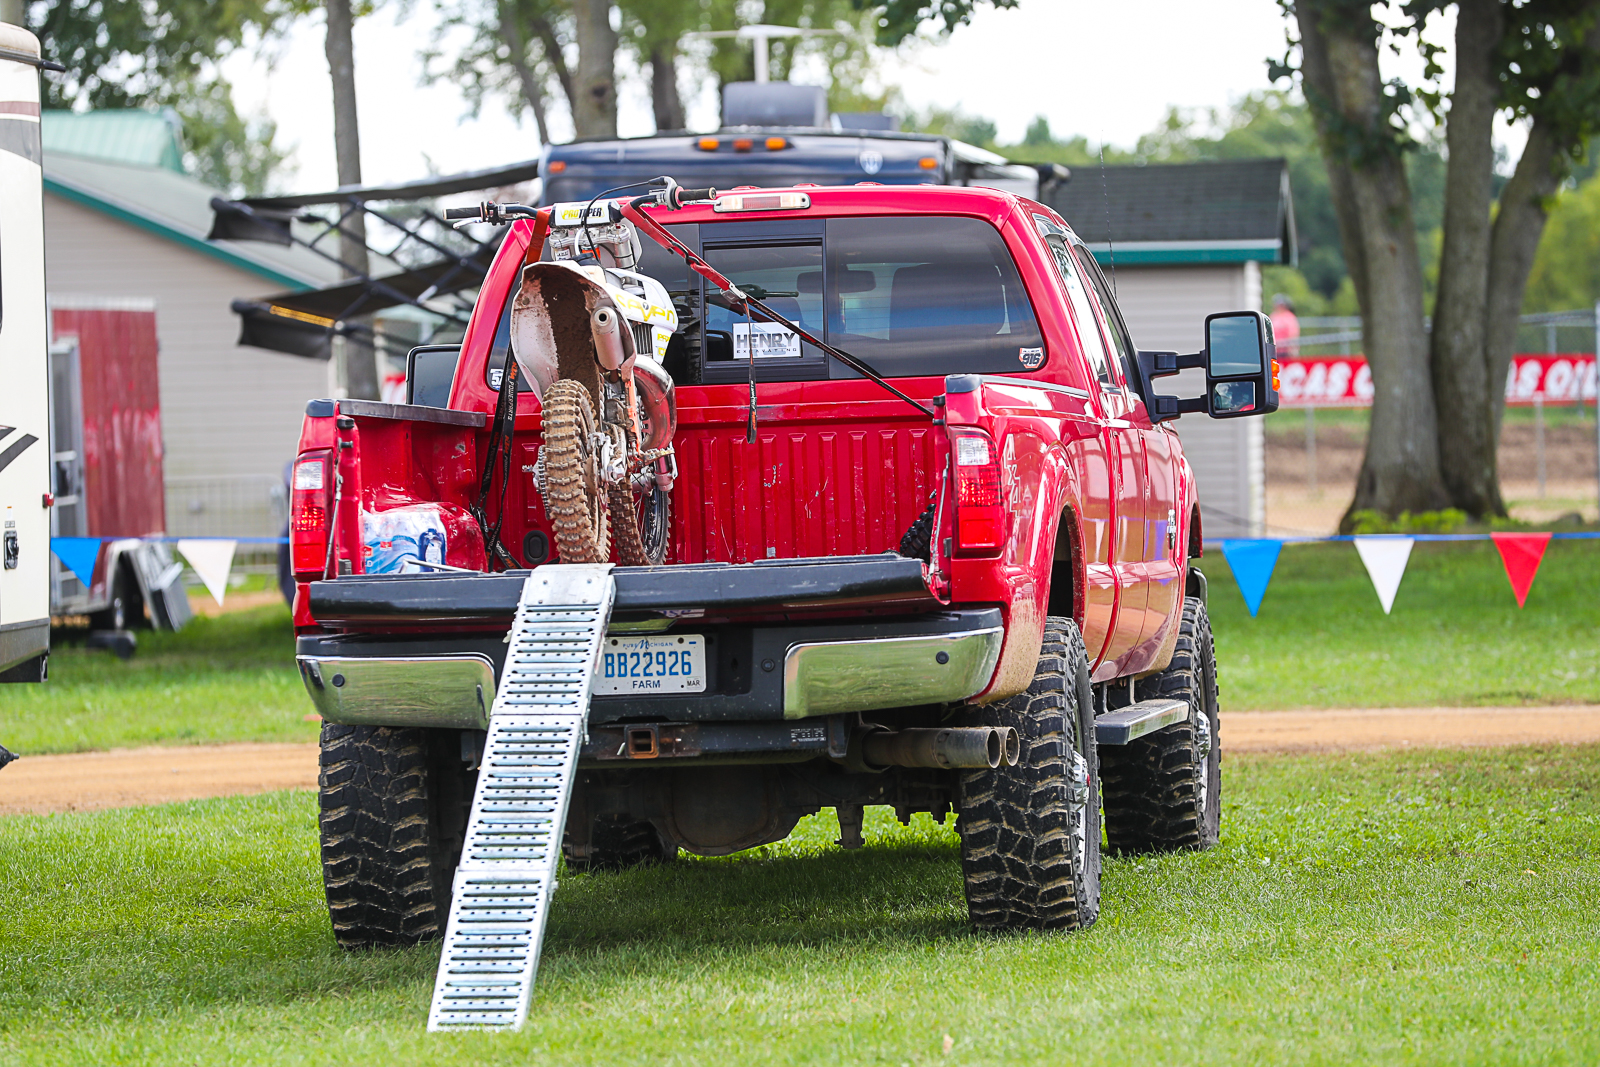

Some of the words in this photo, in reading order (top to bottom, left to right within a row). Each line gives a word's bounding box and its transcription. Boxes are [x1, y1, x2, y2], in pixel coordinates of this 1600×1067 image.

[736, 332, 796, 349] HENRY
[604, 651, 692, 678] BB22926
[632, 679, 661, 689] FARM
[686, 679, 701, 687] MAR
